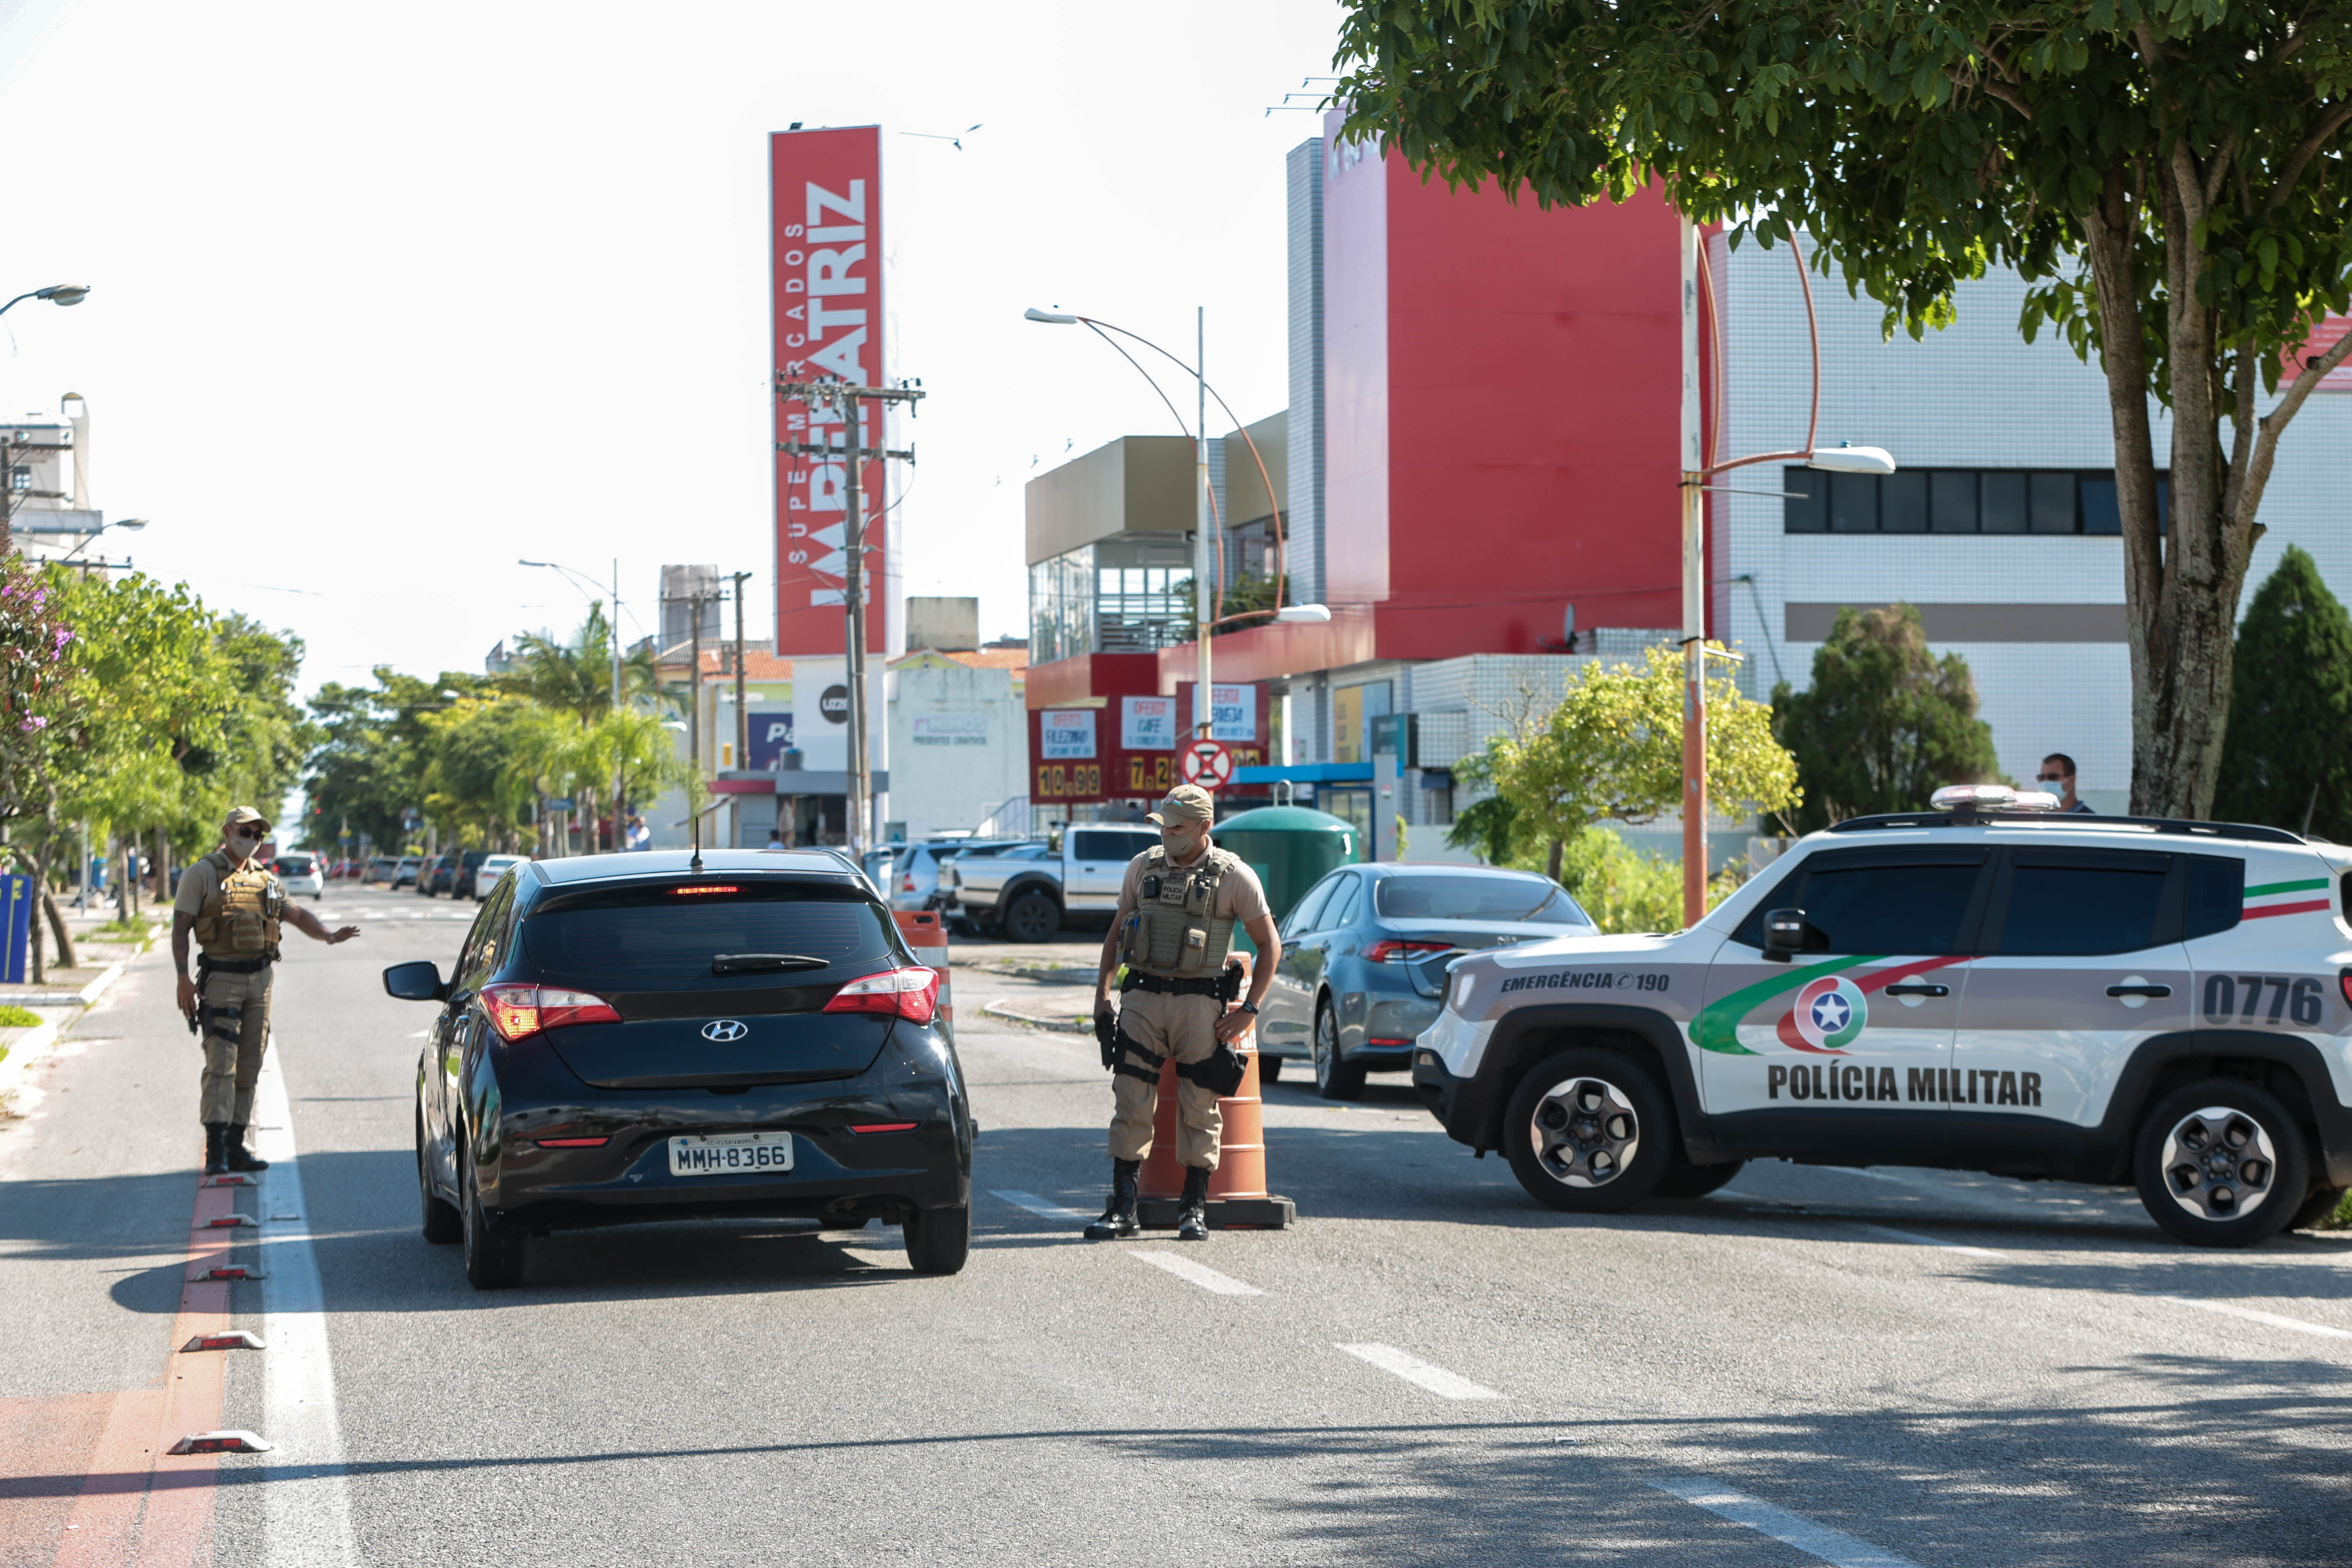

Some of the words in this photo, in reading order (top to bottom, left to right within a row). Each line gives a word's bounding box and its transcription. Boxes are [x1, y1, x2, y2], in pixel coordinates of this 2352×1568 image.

[784, 223, 807, 564] SUPEMRCADOS
[1501, 971, 1613, 993] EMERGÊNCIA
[1636, 974, 1669, 992] 190
[2203, 974, 2323, 1028] 0776
[1769, 1059, 1899, 1101] POLÍCIA
[1908, 1068, 2041, 1106] MILITAR
